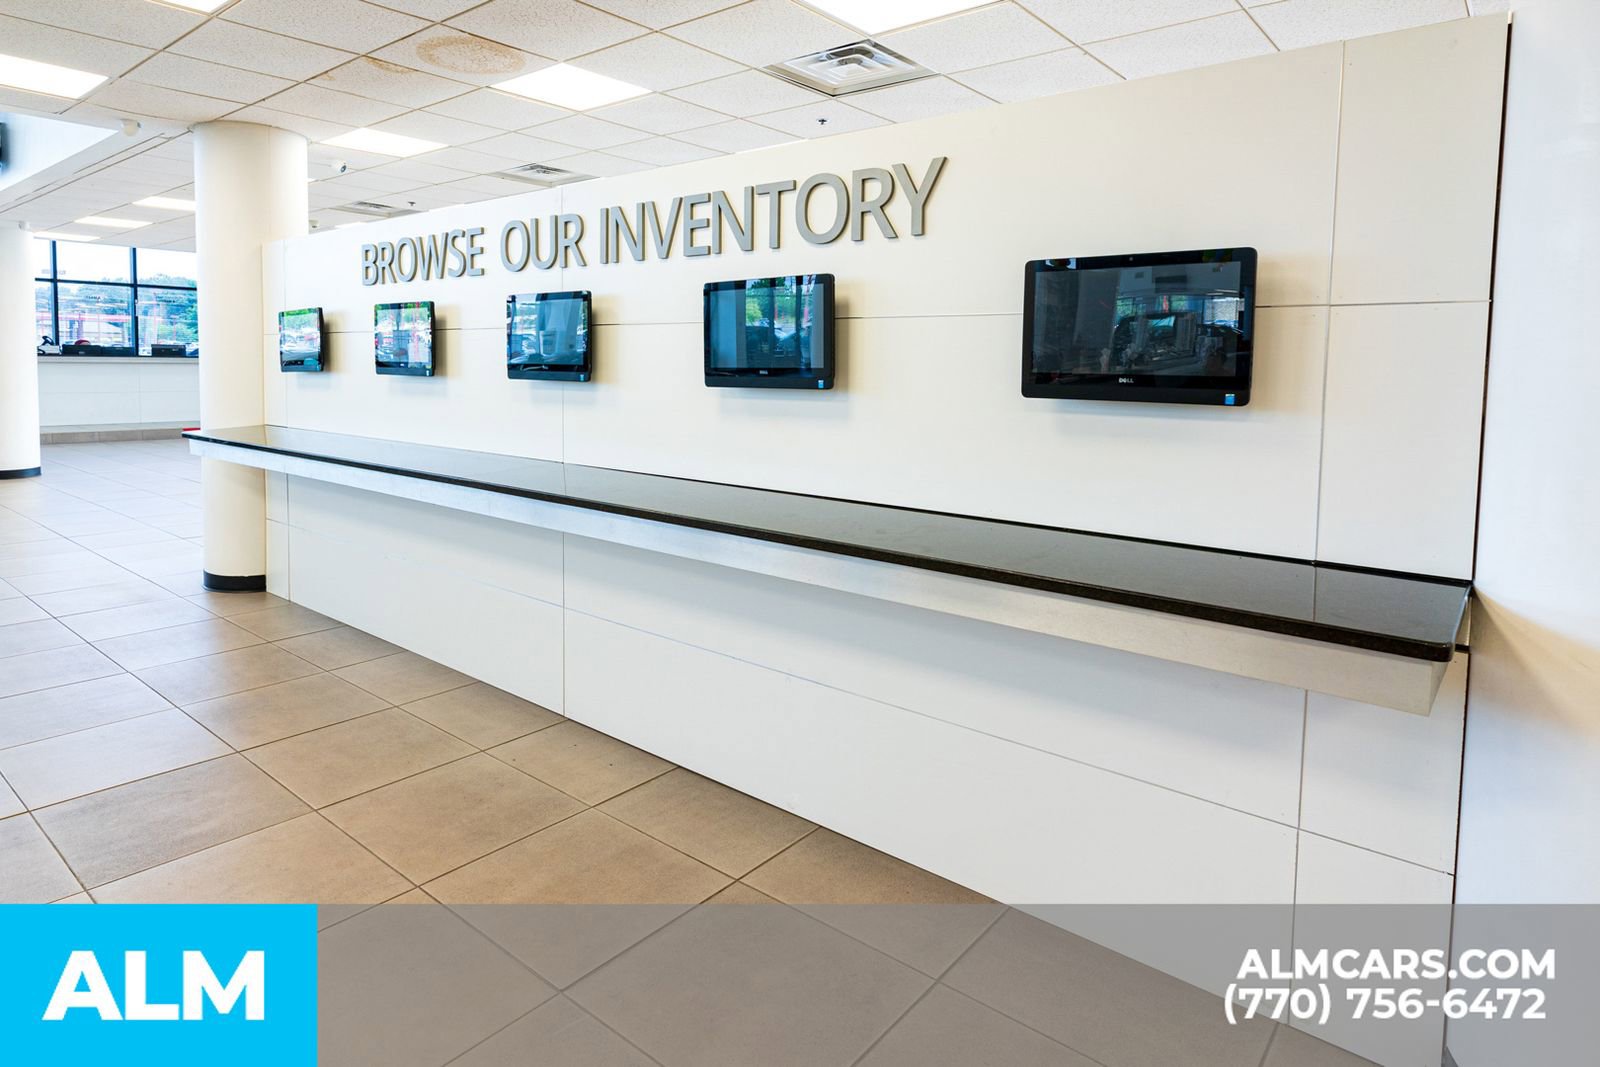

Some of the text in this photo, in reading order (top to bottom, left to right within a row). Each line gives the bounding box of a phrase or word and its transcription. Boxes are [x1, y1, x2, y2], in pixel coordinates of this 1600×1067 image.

[361, 156, 949, 286] BROWSE OUR INVENTORY
